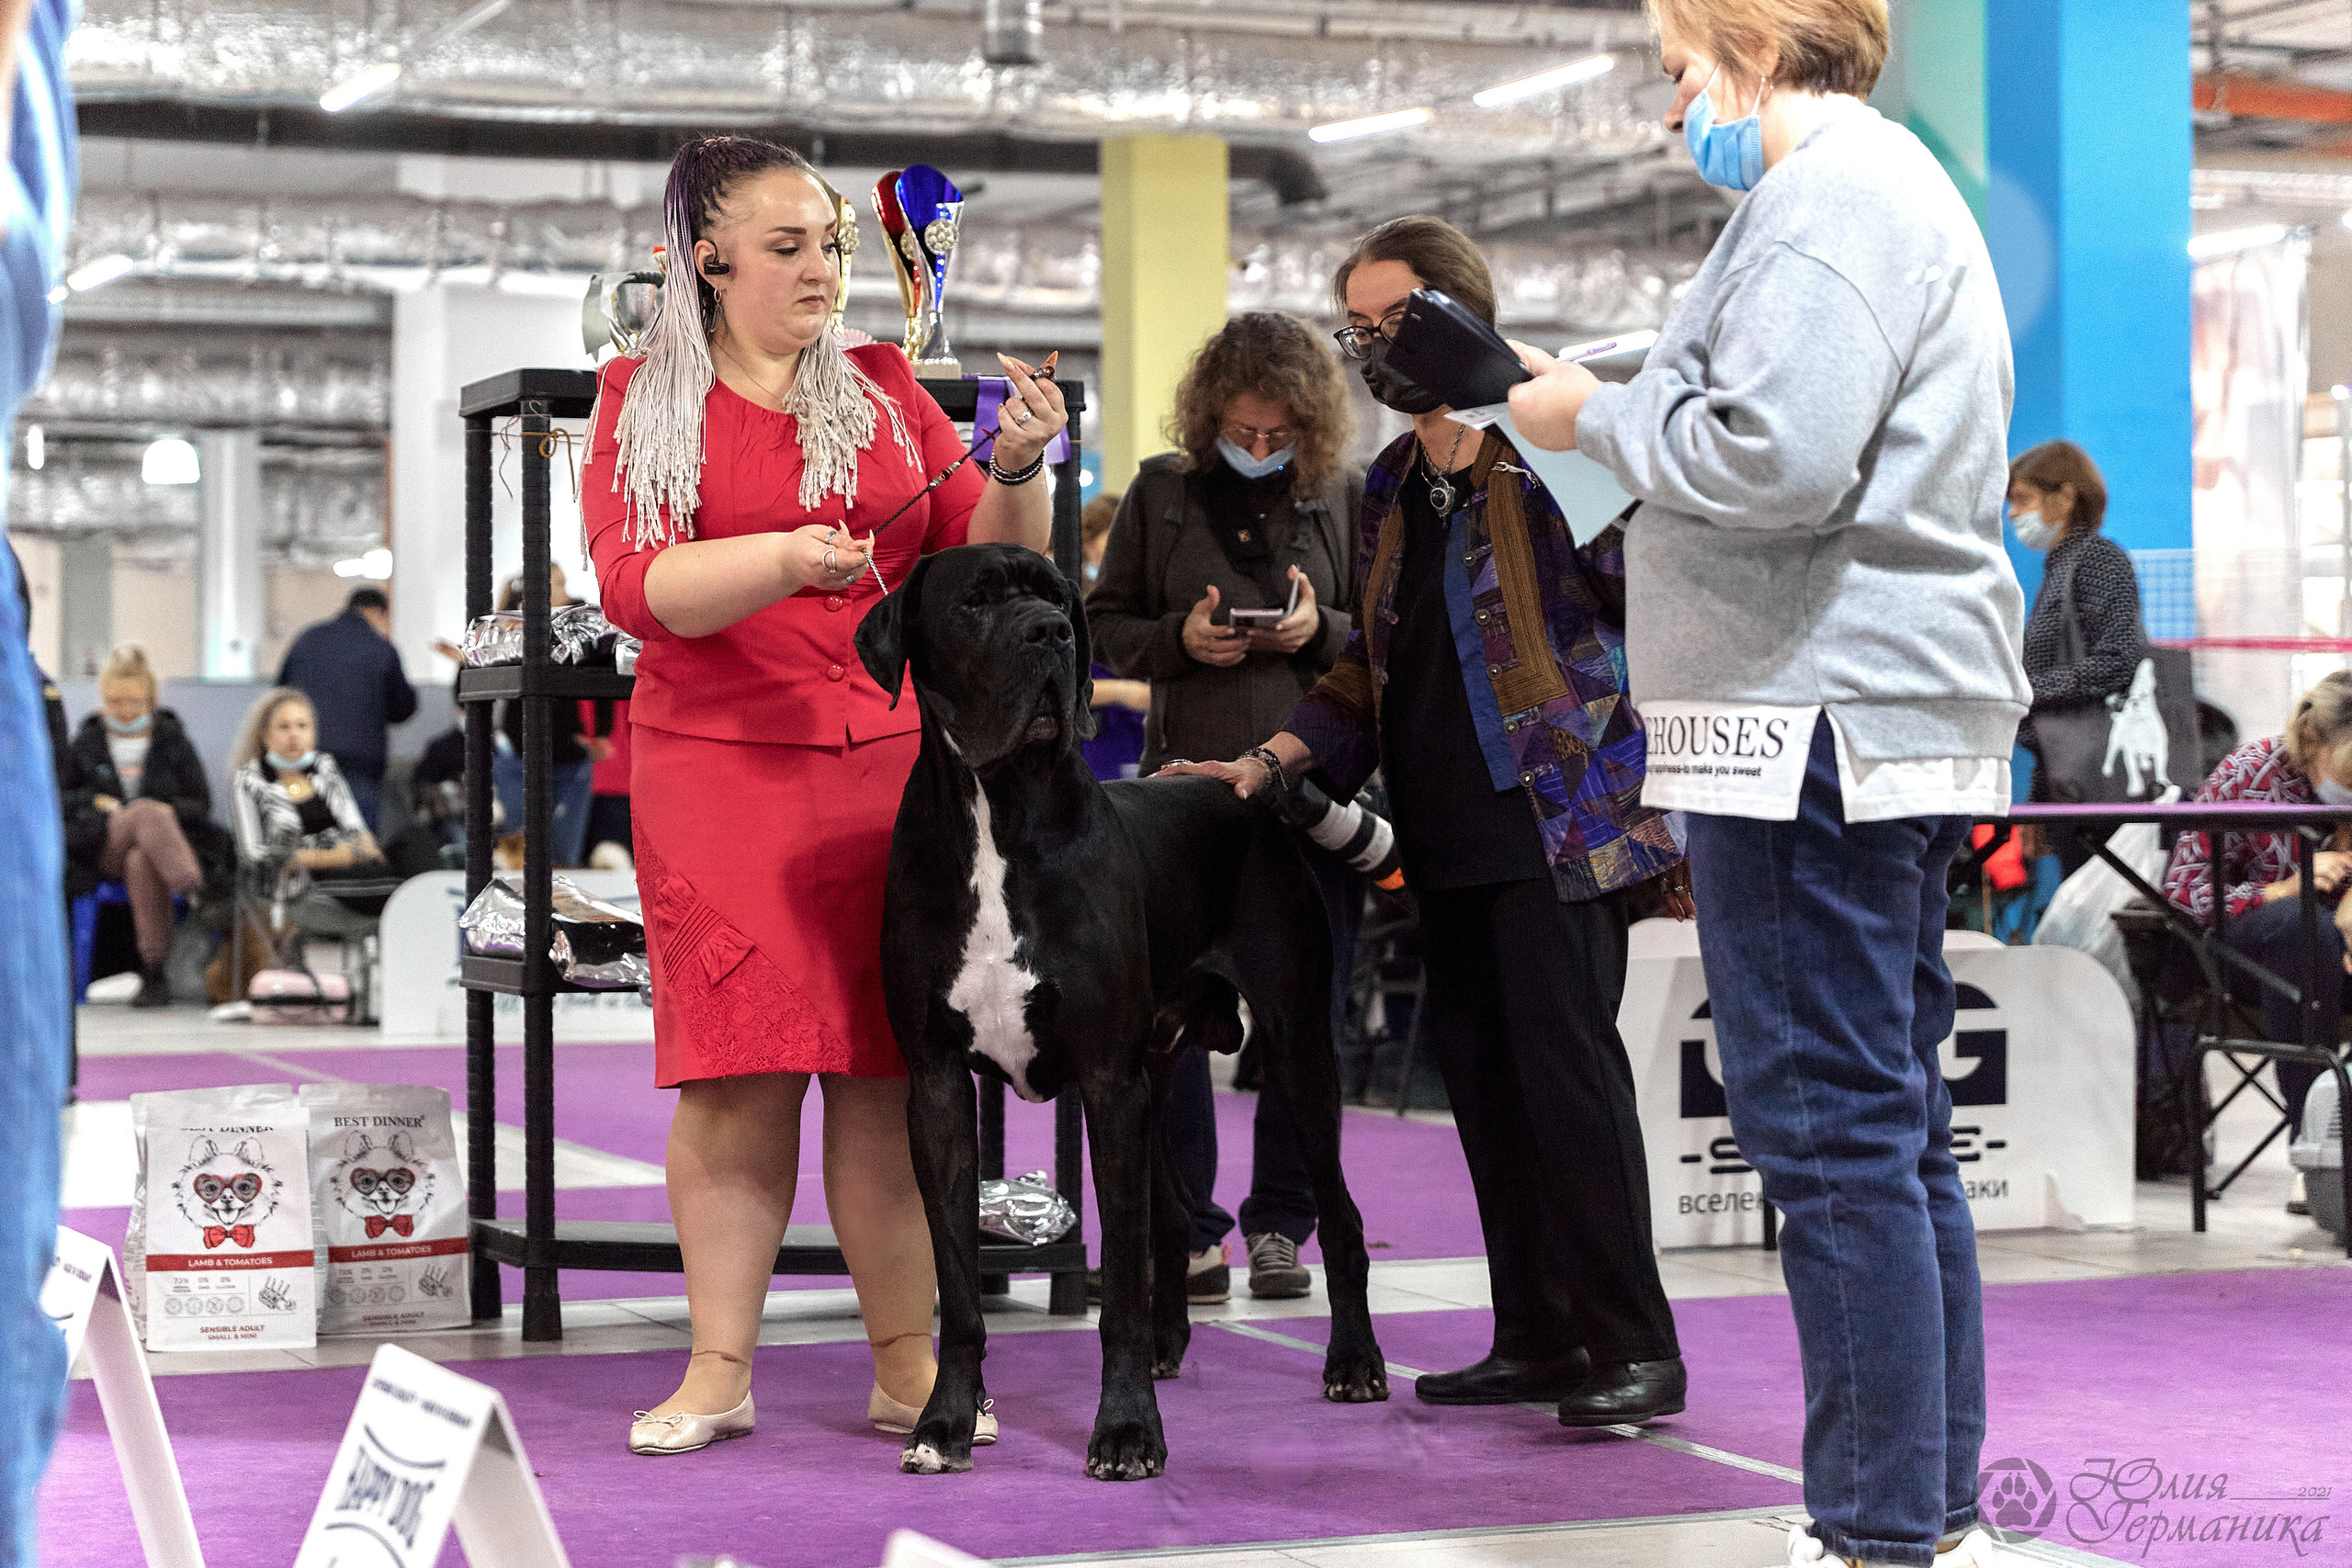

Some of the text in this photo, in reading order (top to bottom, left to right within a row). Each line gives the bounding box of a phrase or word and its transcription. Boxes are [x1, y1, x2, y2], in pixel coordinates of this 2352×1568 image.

[1691, 762, 1713, 774] make
[1714, 765, 1731, 777] you
[1733, 764, 1762, 777] sweet
[334, 1116, 369, 1127] BEST
[351, 1246, 432, 1258] LAMB & TOMATOES
[188, 1257, 273, 1268] LAMB & TOMATOES
[199, 1325, 237, 1334] SENSIBLE
[334, 1444, 398, 1517] HAPPY
